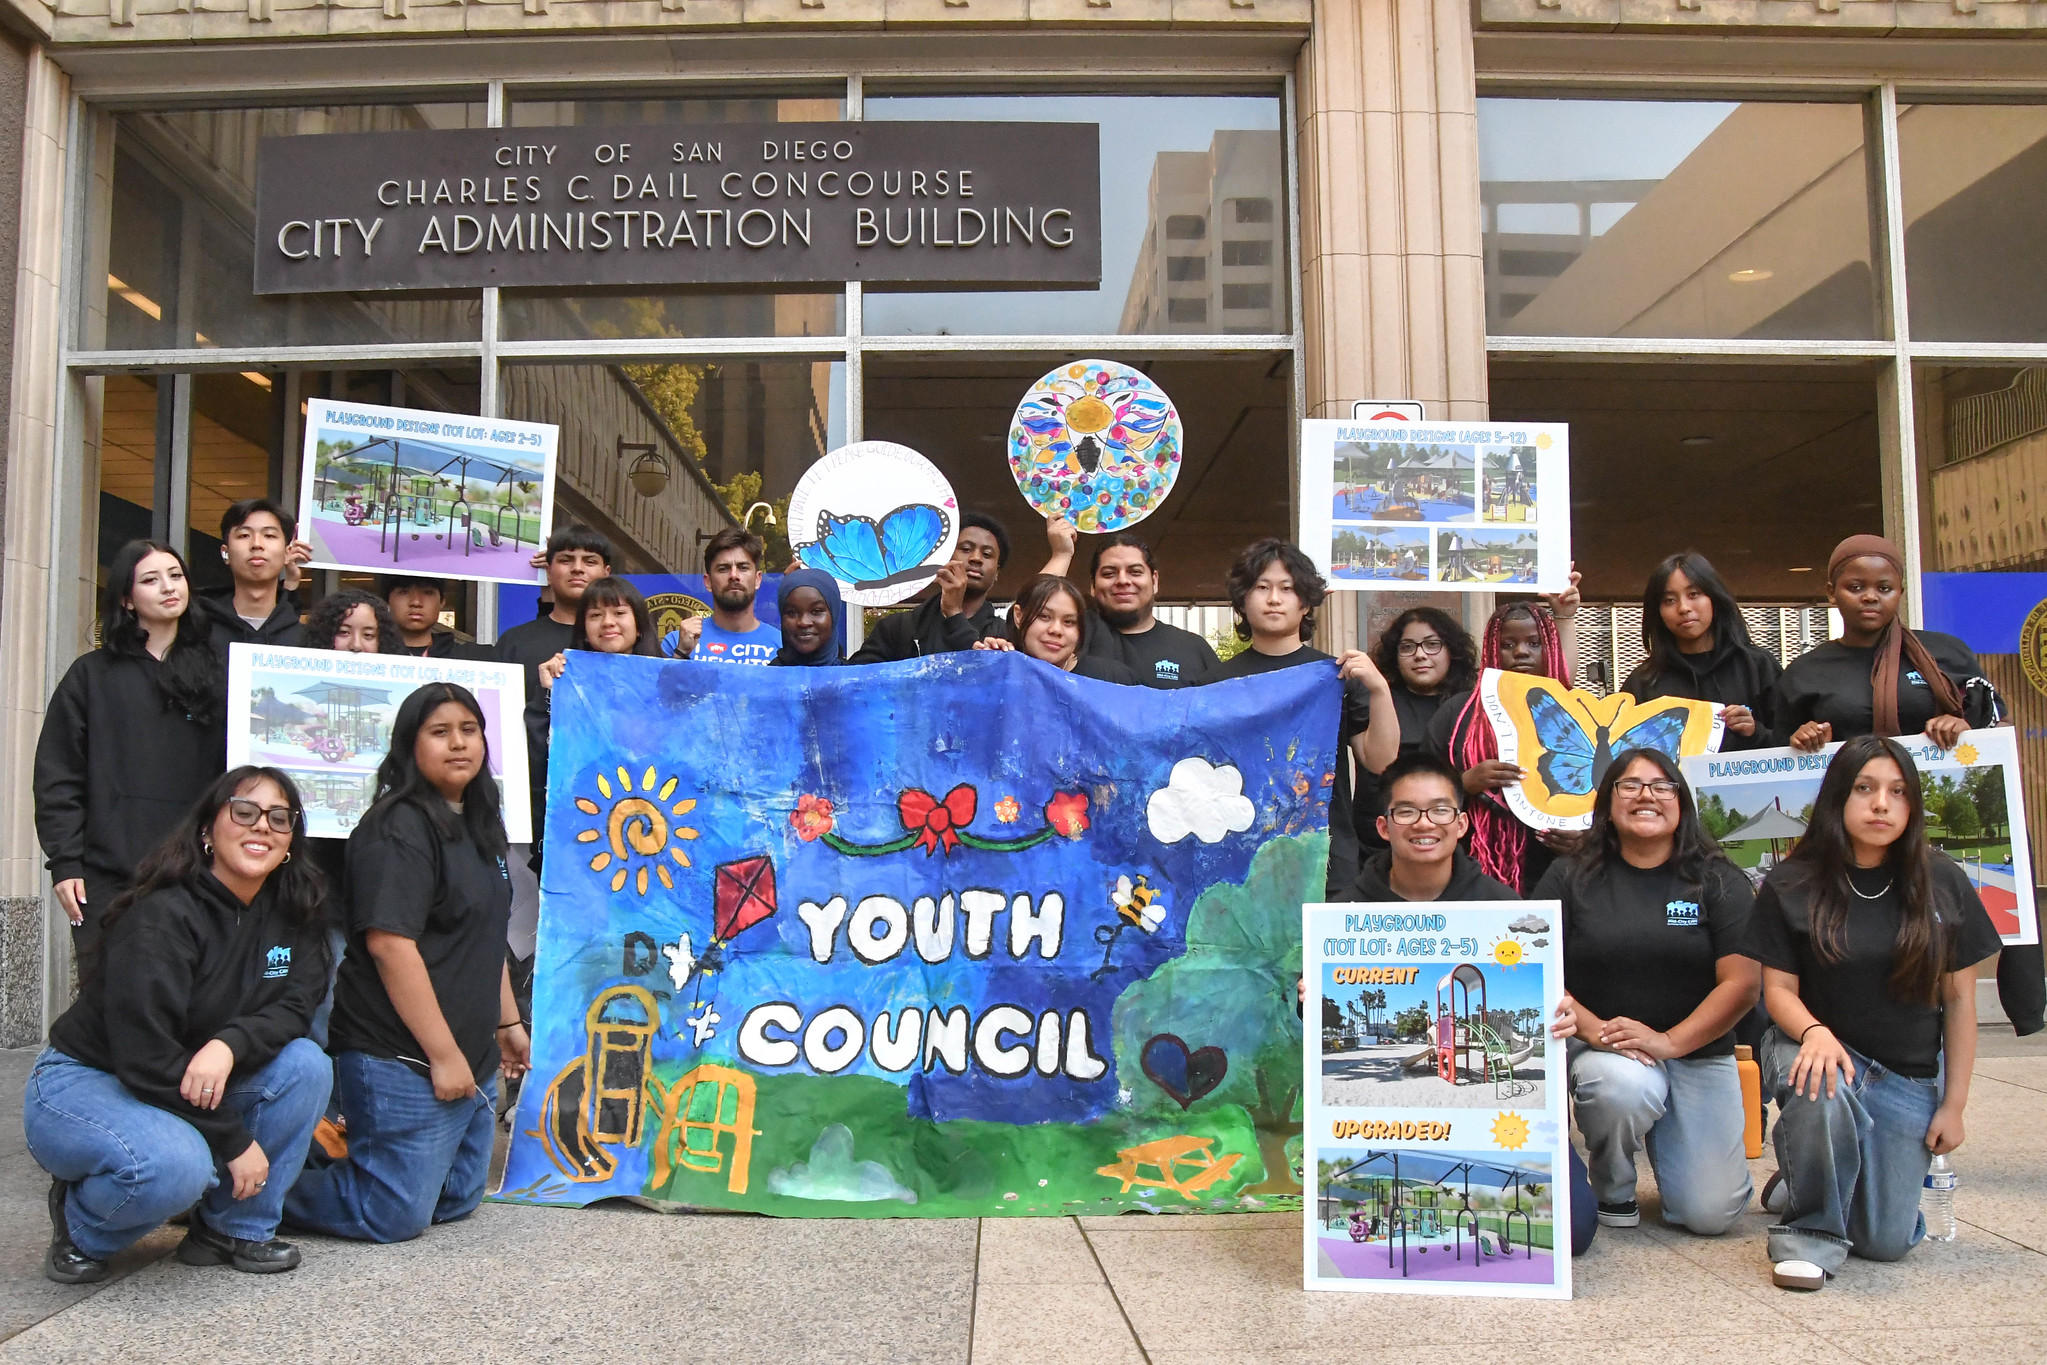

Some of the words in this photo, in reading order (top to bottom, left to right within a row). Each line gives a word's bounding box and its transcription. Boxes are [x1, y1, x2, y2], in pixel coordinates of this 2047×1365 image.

[495, 145, 557, 167] CITY
[595, 144, 631, 164] OF
[673, 142, 722, 162] SAN
[763, 140, 853, 160] DIEGO
[377, 176, 541, 206] CHARLES
[567, 175, 595, 201] C.
[613, 173, 697, 200] DAIL
[721, 170, 974, 199] CONCOURSE
[278, 217, 383, 260] CITY
[418, 208, 811, 255] ADMINISTRATION
[856, 206, 1074, 249] BUILDING
[326, 410, 394, 430] PLAYGROUND
[397, 419, 440, 435] DESIGNS
[442, 424, 464, 439] (TOT
[466, 427, 488, 440] LOT:
[490, 430, 516, 444] AGES
[518, 434, 543, 447] 2-5)
[1337, 427, 1408, 442] PLAYGROUND
[1410, 429, 1457, 443] DESIGNS
[1459, 431, 1492, 444] (AGES
[1495, 432, 1527, 444] 5-12)
[731, 644, 774, 658] CITY
[252, 653, 332, 672] PLAYGROUND
[336, 659, 387, 677] DESIGNS
[390, 664, 415, 680] (TOT
[446, 668, 476, 683] AGES
[1709, 757, 1795, 778] PLAYGROUND
[1513, 793, 1567, 827] ANYONE
[797, 887, 1065, 965] YOUTH
[1345, 914, 1446, 932] PLAYGROUND
[1324, 938, 1358, 957] (TOT
[1360, 938, 1393, 957] LOT:
[1396, 938, 1436, 957] AGES
[1440, 937, 1479, 957] 2-5)
[1333, 966, 1419, 985] CURRENT
[737, 1000, 1109, 1082] COUNCIL
[1332, 1119, 1452, 1142] UPGRADED!
